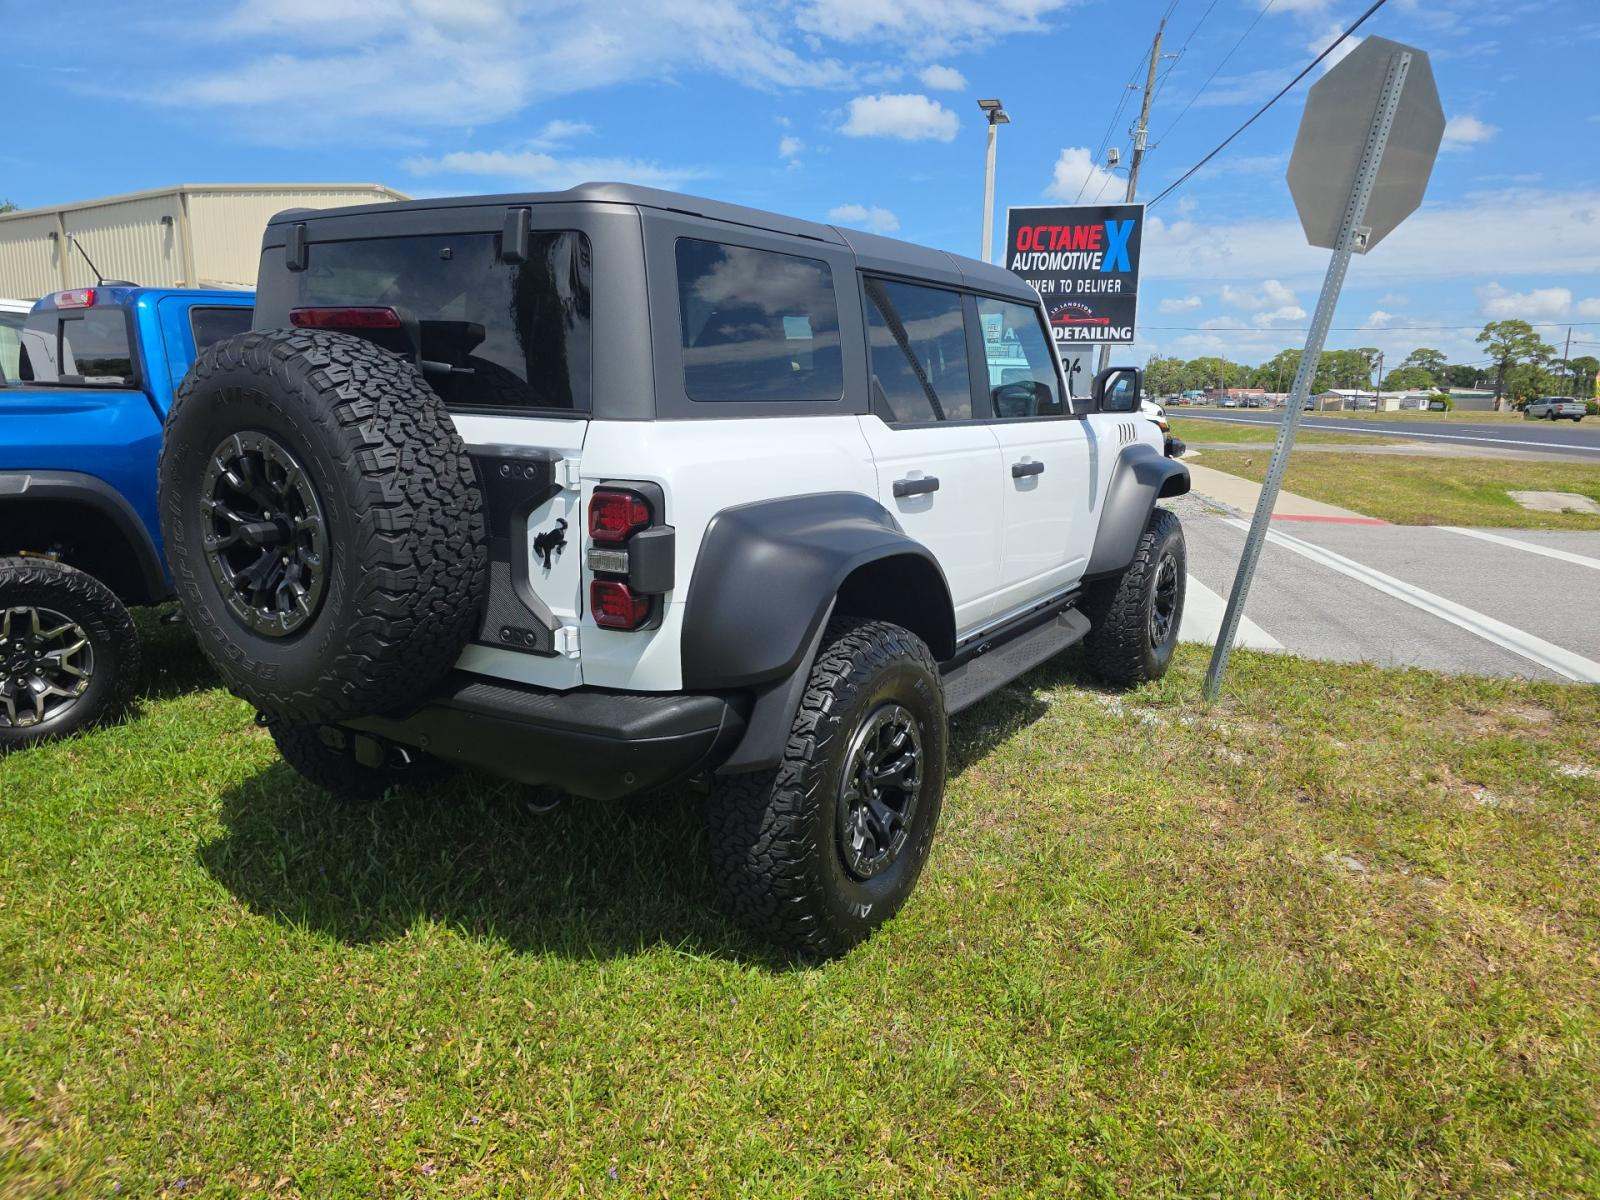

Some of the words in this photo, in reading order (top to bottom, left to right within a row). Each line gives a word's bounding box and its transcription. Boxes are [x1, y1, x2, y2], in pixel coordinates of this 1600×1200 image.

[1017, 225, 1104, 251] OCTANE
[1101, 220, 1135, 272] X
[1011, 252, 1103, 271] AUTOMOTIVE
[1025, 279, 1055, 293] RIVEN
[1060, 279, 1073, 293] TO
[1077, 279, 1121, 293] DELIVER
[1055, 327, 1131, 340] DETAILING
